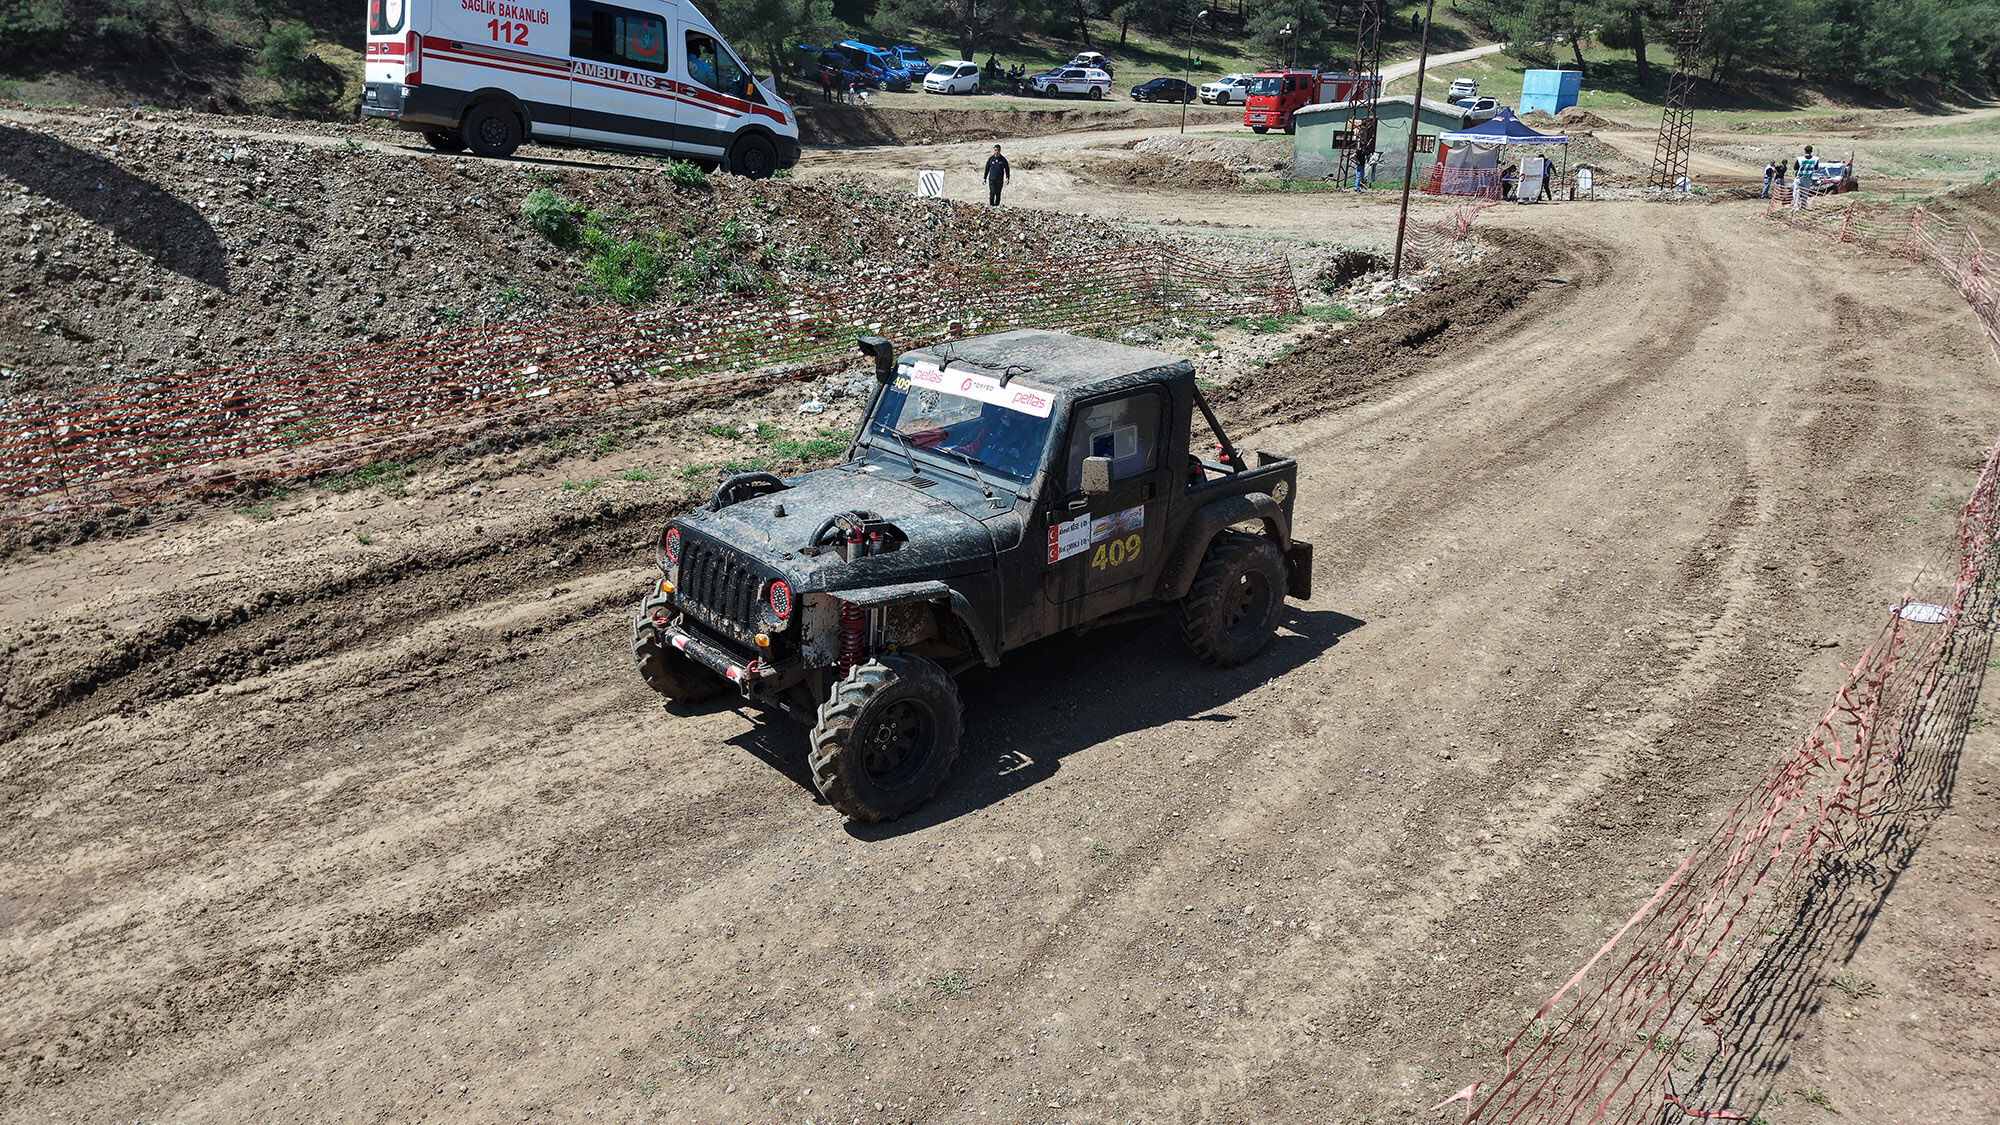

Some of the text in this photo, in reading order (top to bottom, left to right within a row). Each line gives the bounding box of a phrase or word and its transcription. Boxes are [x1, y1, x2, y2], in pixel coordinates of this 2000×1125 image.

[499, 2, 549, 25] BAKANLIĞI
[487, 18, 529, 46] 112
[573, 61, 657, 88] AMBULANS
[892, 376, 911, 391] 409
[1091, 534, 1142, 571] 409
